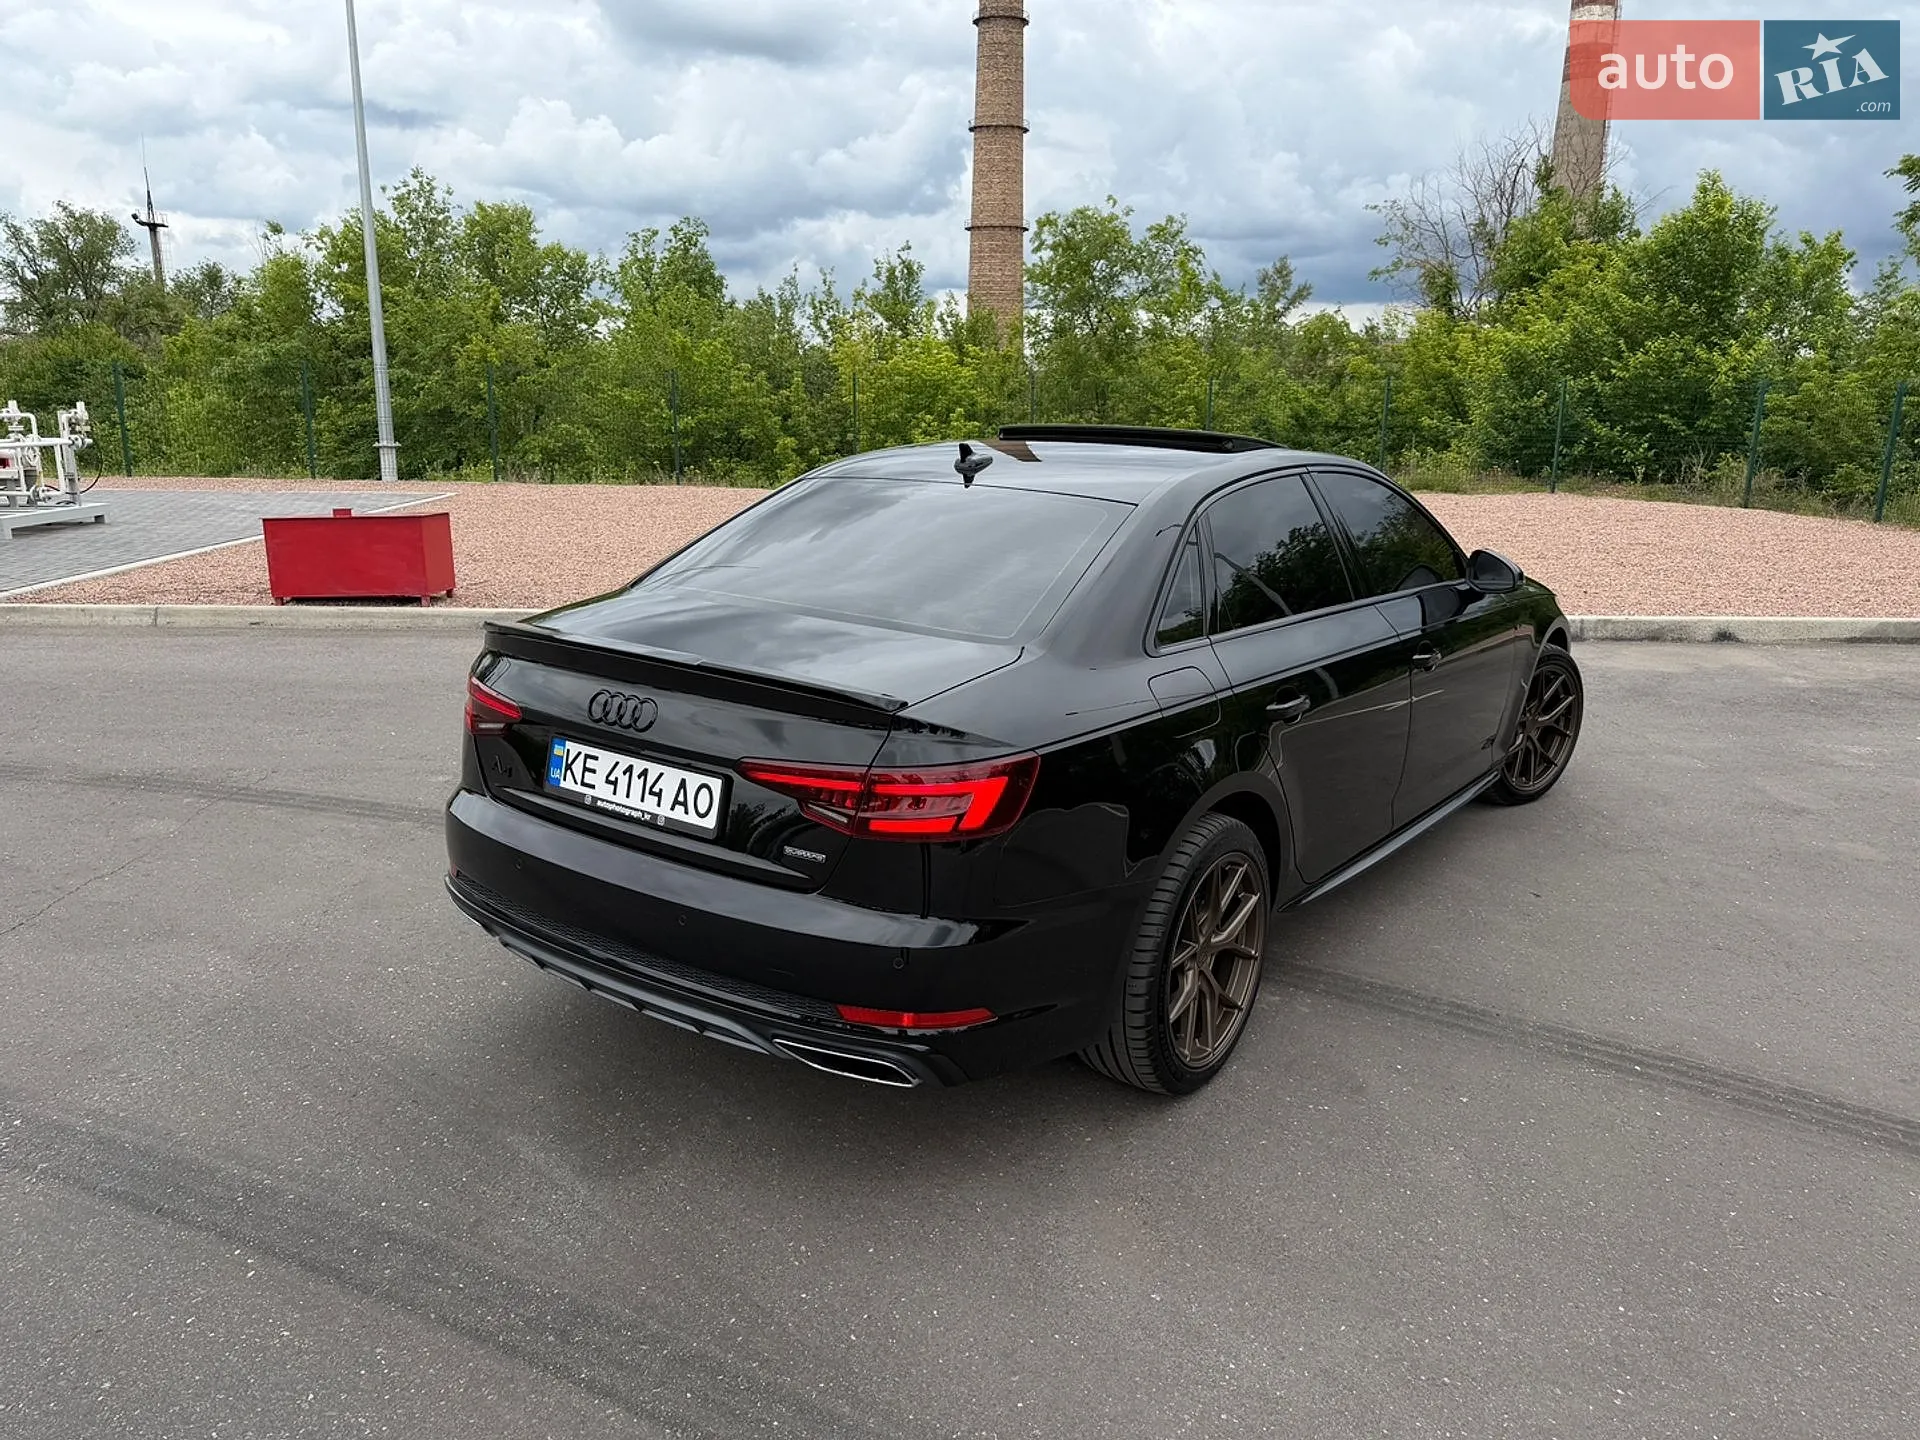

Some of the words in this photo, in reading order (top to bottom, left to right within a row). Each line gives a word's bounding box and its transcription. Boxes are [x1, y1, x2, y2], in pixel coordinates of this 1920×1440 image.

[563, 748, 599, 790] KE
[605, 761, 664, 808] 4114
[670, 777, 714, 819] AO
